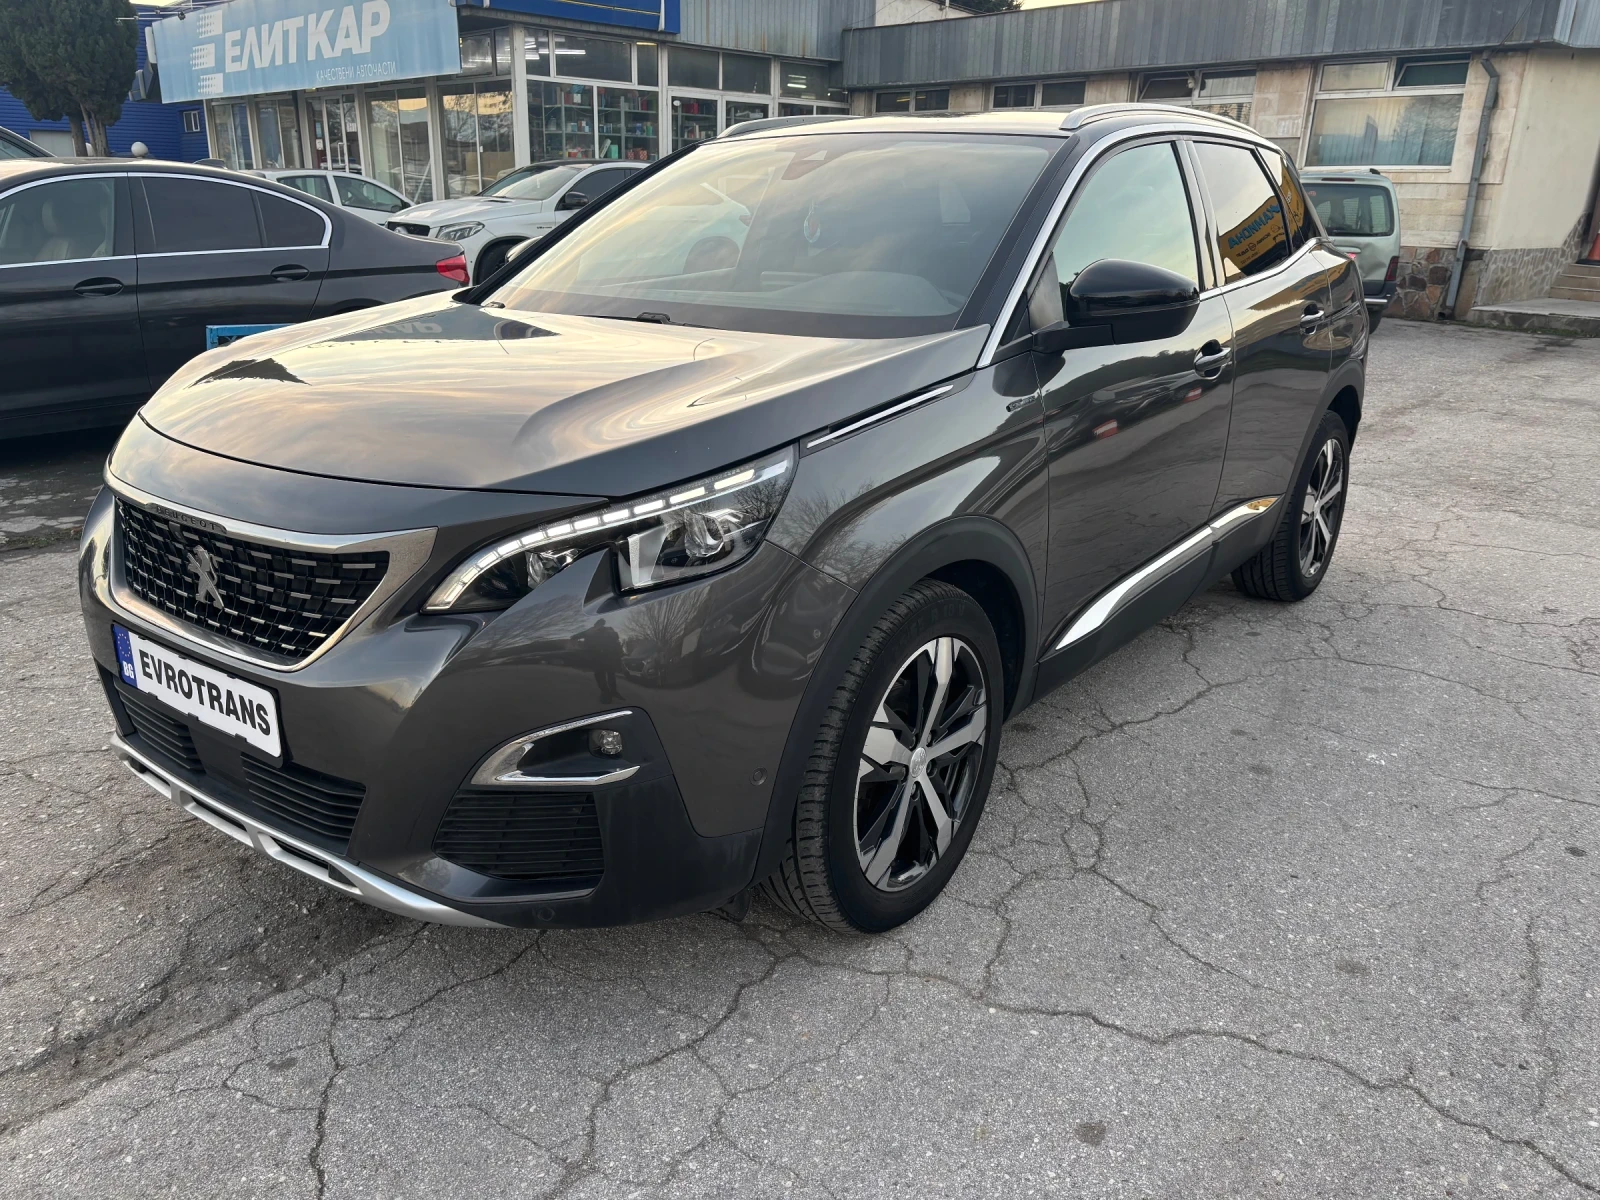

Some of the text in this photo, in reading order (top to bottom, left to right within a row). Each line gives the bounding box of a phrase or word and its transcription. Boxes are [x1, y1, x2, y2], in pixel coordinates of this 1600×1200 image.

[316, 61, 397, 82] КАЧЕСТВЕНИ АВТОЧАСТИ
[156, 505, 217, 531] PEUGEOT
[122, 660, 135, 680] BG
[138, 648, 272, 737] EVROTRANS
